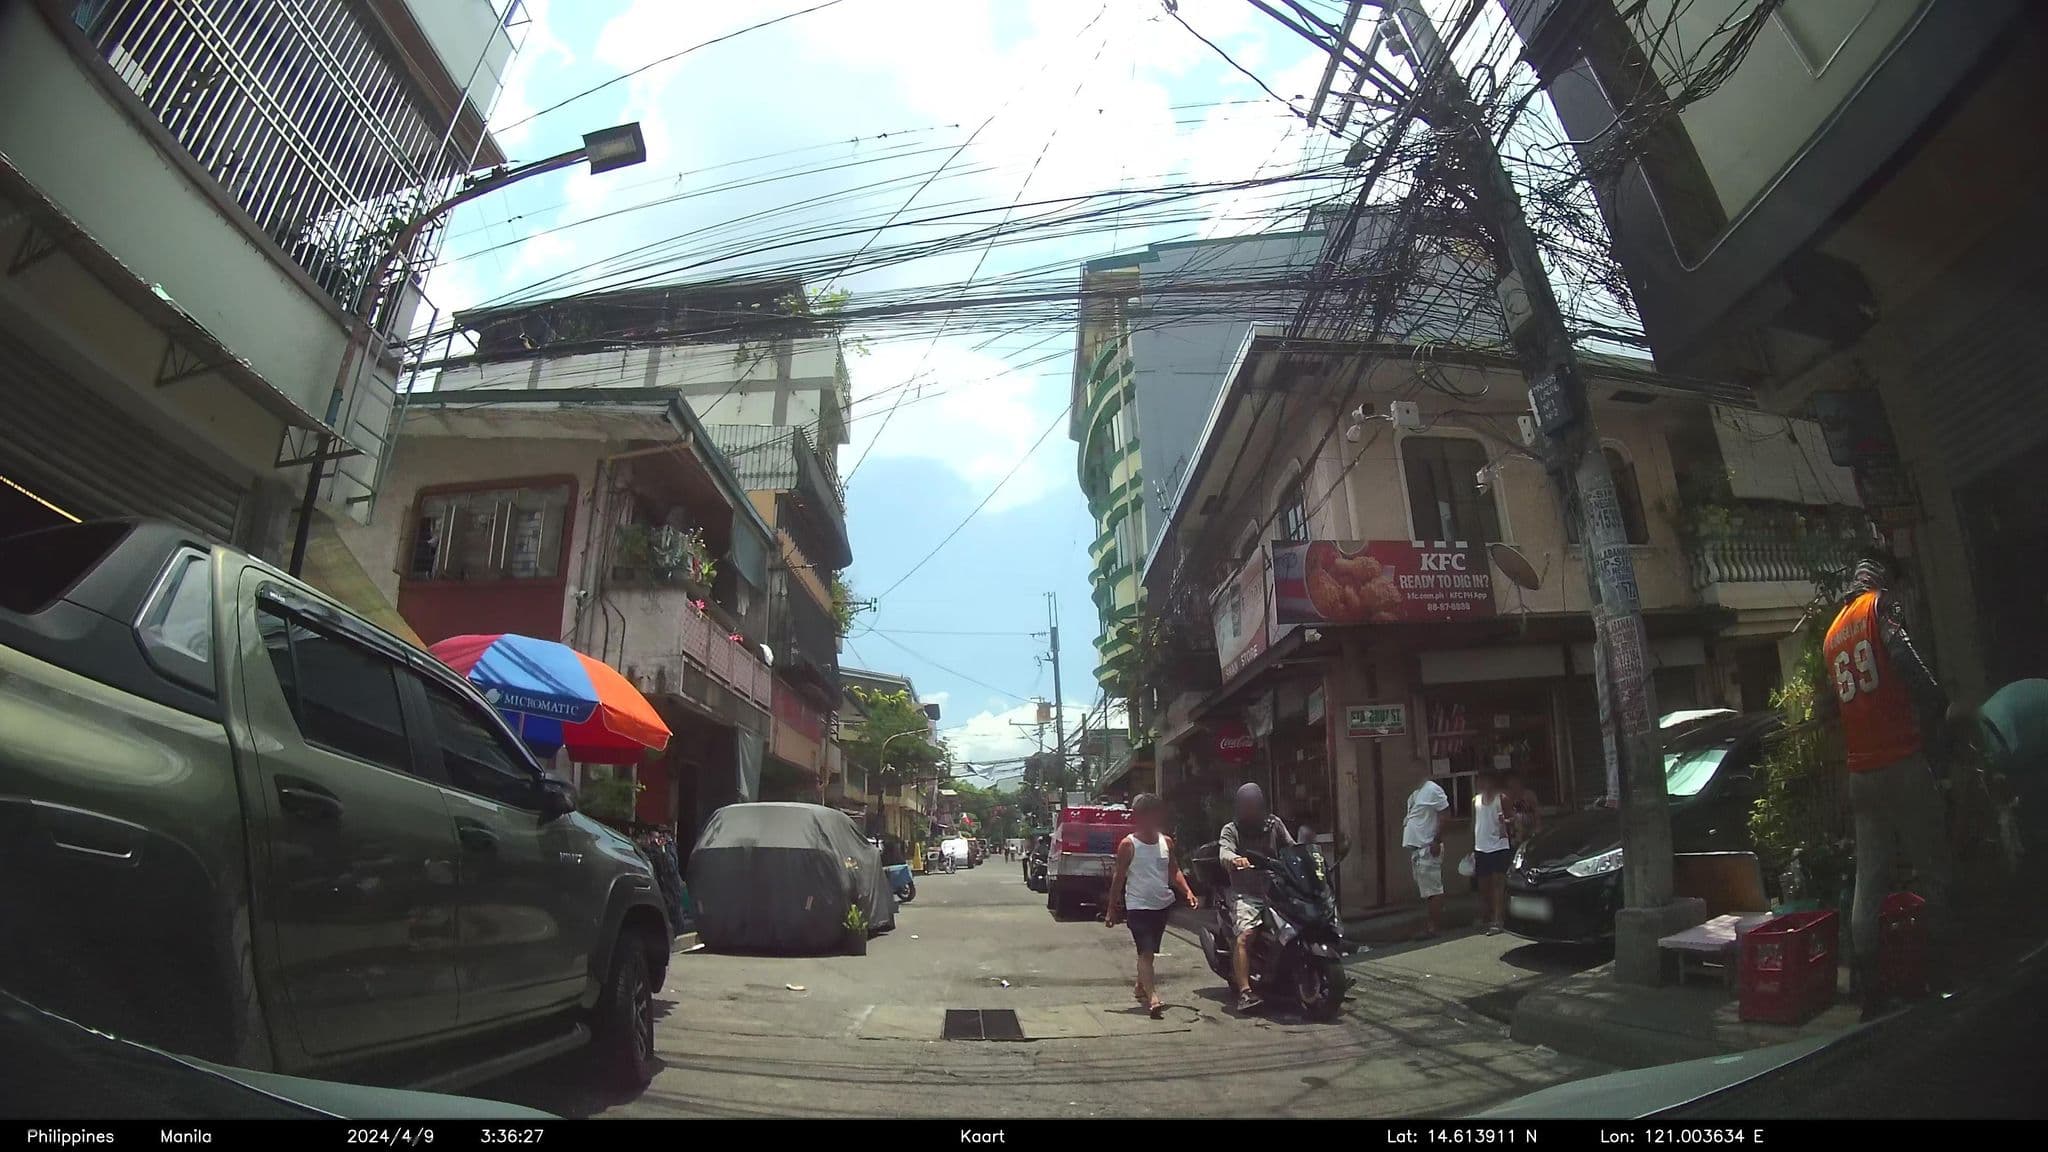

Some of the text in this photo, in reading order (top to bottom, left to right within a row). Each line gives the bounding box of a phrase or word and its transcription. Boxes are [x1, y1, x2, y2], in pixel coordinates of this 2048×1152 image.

[1420, 553, 1467, 571] KFC
[1400, 574, 1489, 589] READY TO DIG IN?
[1473, 592, 1488, 600] App
[1240, 644, 1258, 667] STORE
[1834, 639, 1879, 703] 69
[504, 694, 578, 715] MICROMATIC
